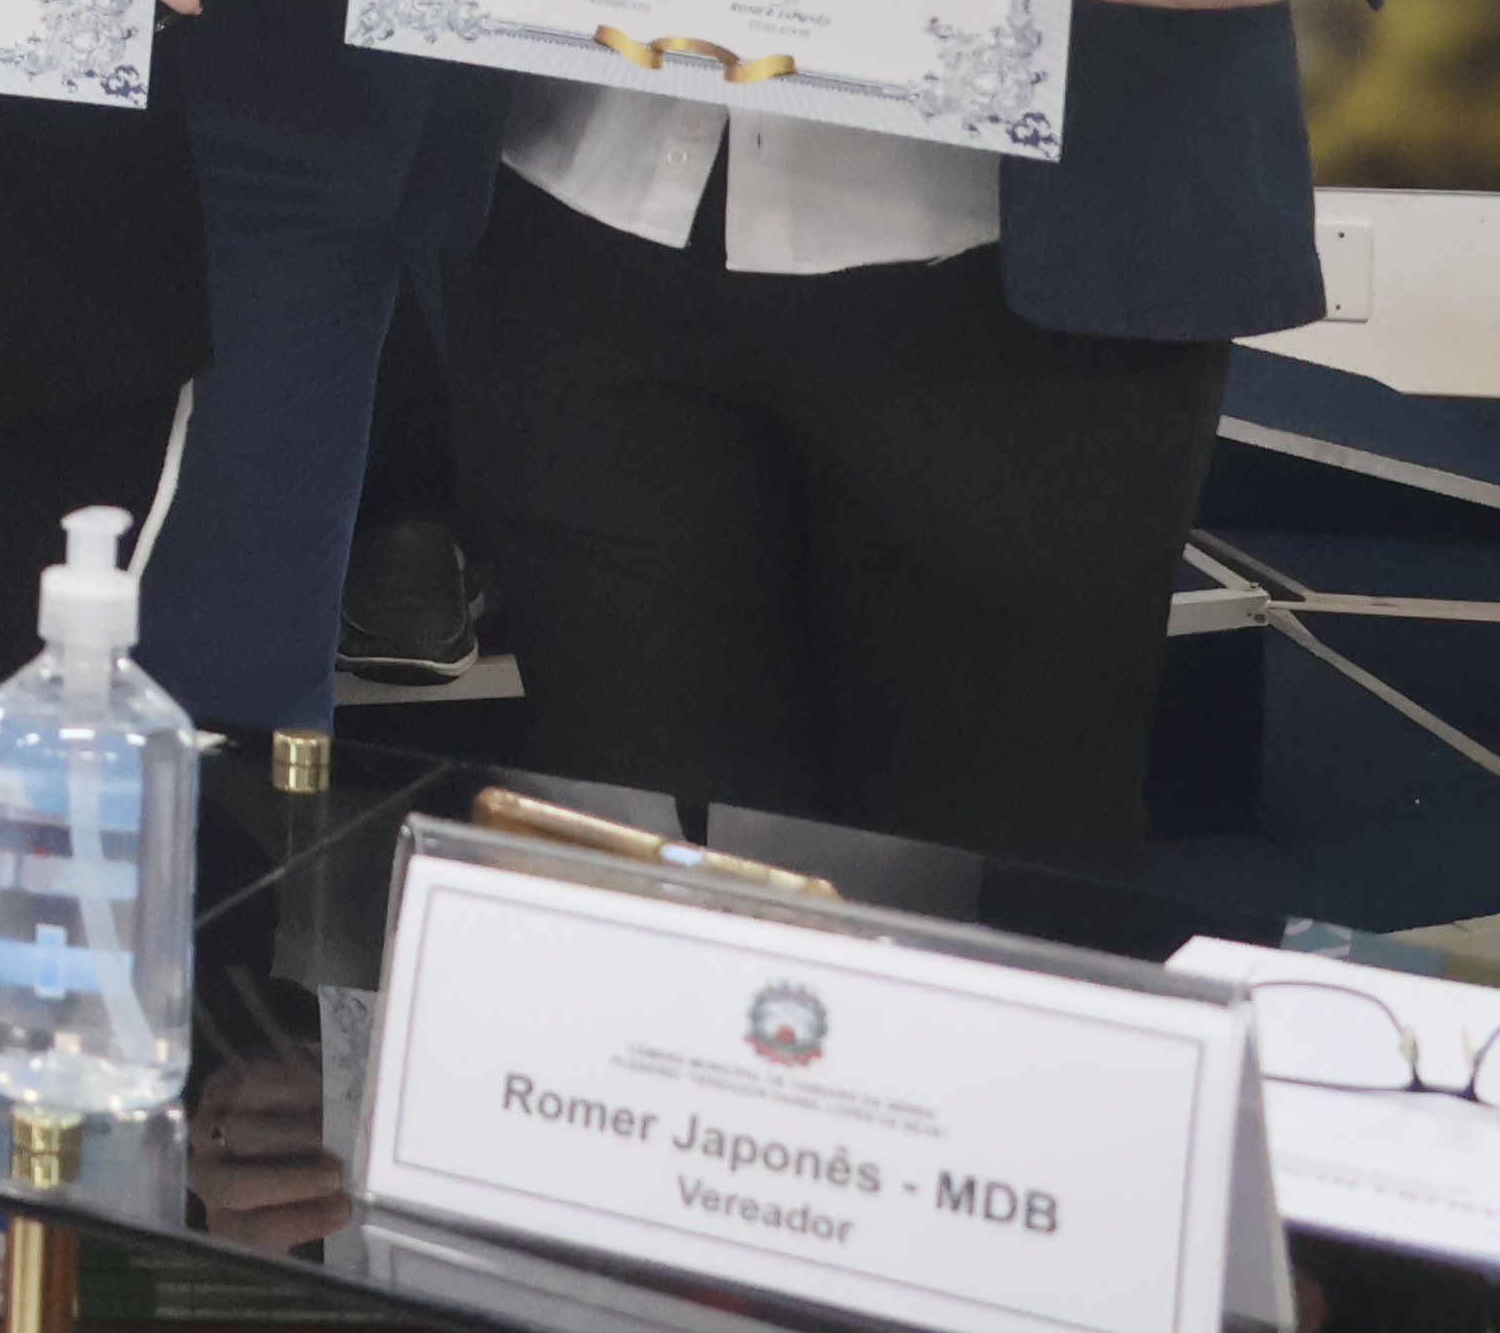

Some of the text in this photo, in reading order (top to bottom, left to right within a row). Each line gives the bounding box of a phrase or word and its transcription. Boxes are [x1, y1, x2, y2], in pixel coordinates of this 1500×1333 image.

[502, 1071, 658, 1140] Romer
[673, 1112, 883, 1194] Japonês
[935, 1168, 1062, 1237] MDB
[676, 1174, 853, 1247] Vereador
